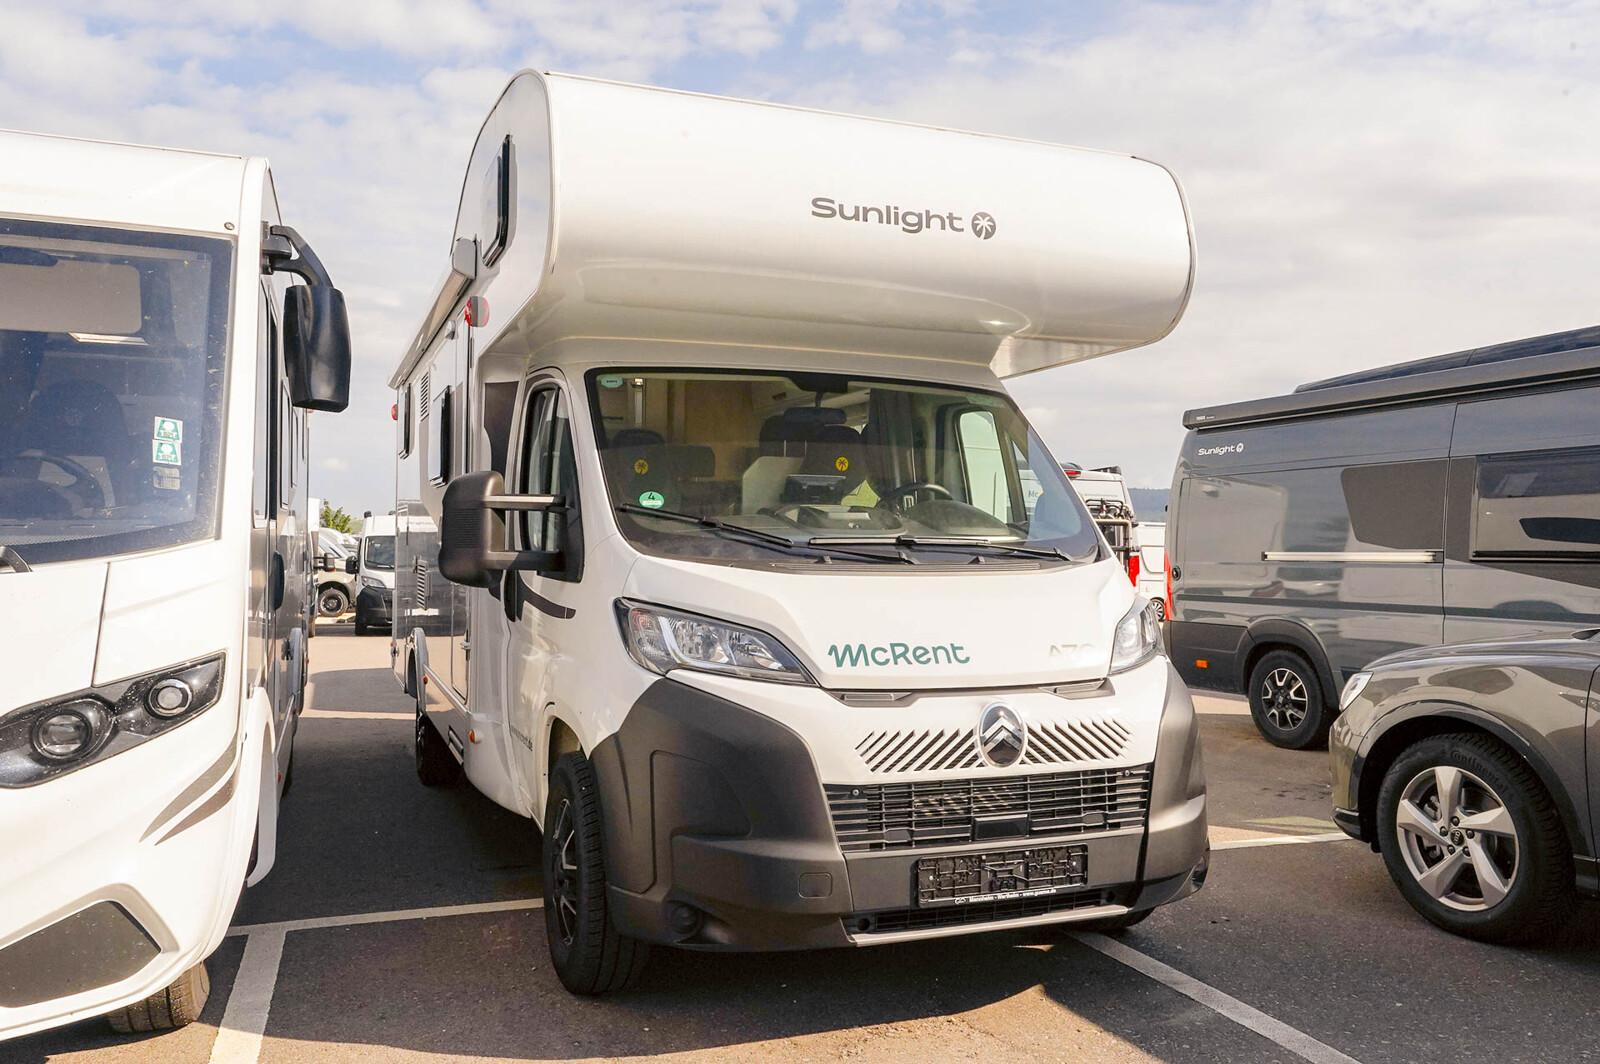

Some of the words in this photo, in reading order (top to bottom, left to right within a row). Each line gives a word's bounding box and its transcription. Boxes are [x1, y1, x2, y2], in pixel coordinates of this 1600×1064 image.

[811, 197, 965, 234] Sunlight
[1198, 445, 1236, 456] Sunlight
[828, 642, 970, 668] McRent
